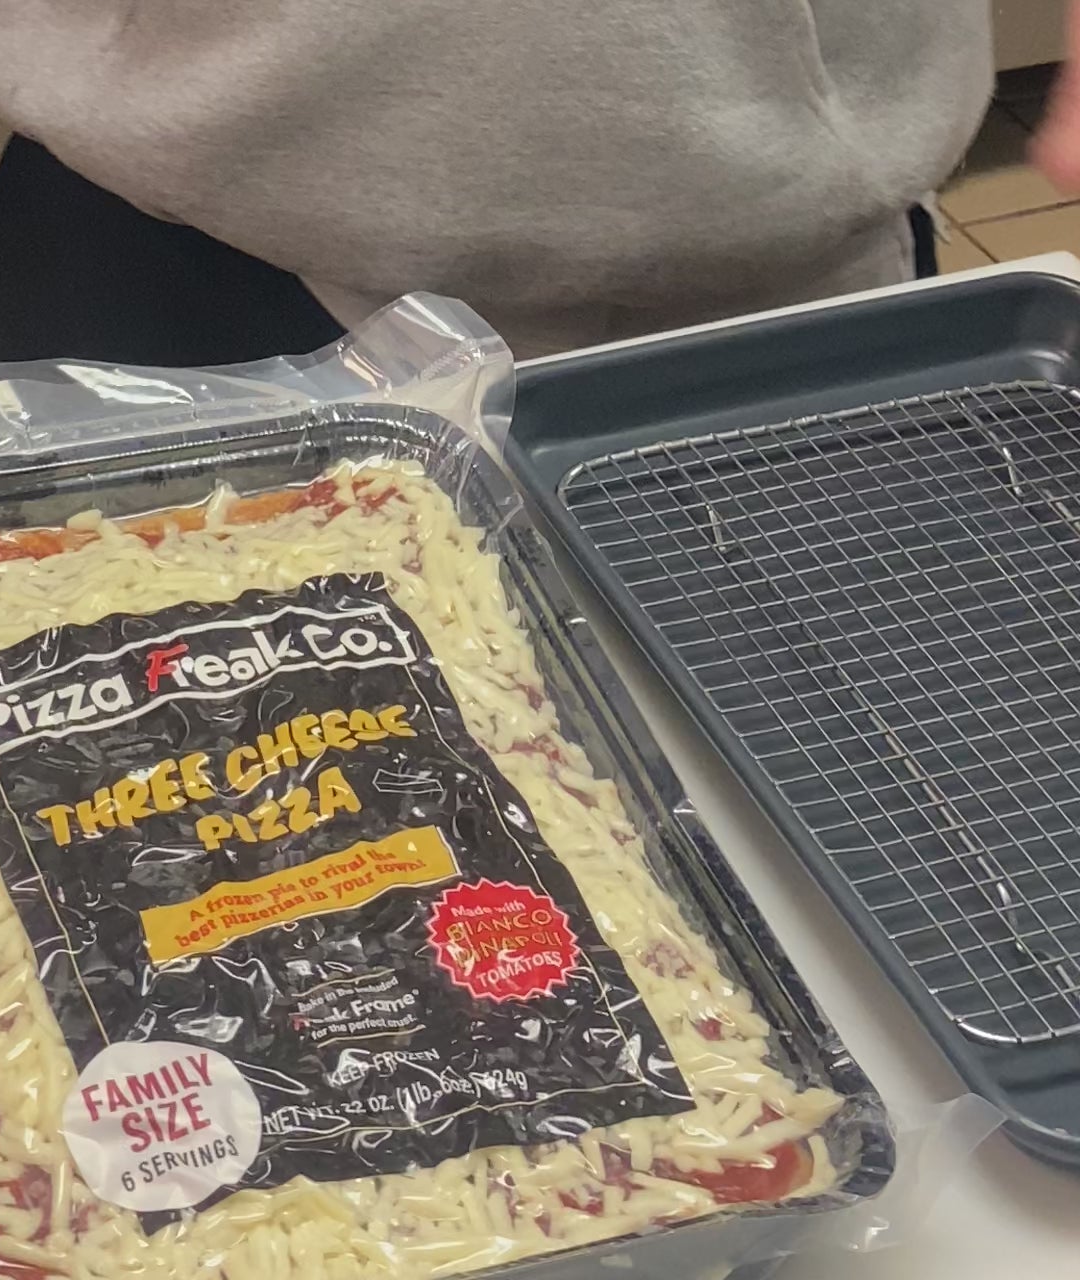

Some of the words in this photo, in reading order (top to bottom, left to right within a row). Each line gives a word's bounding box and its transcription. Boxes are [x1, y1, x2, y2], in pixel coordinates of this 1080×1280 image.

[145, 627, 304, 693] Freak
[300, 623, 394, 658] Co.
[37, 752, 219, 847] THREE
[225, 704, 419, 792] CHEESE
[195, 766, 362, 853] PIZZA
[174, 919, 218, 947] best
[219, 895, 306, 929] pizzerias
[308, 890, 329, 902] in
[330, 871, 375, 900] your
[190, 909, 205, 922] A
[206, 893, 266, 913] frozen
[298, 876, 319, 888] to
[321, 853, 367, 879] rival
[366, 848, 397, 862] the
[450, 904, 493, 918] Made
[493, 899, 526, 914] with
[446, 908, 553, 941] BIANCO
[475, 950, 563, 988] TOMATOES
[311, 1027, 328, 1040] for
[372, 1048, 440, 1072] FROZEN
[81, 1053, 213, 1122] FAMILY
[121, 1093, 212, 1153] SIZE
[263, 1105, 301, 1134] NET
[121, 1170, 136, 1192] 6
[138, 1134, 239, 1183] SERVINGS
